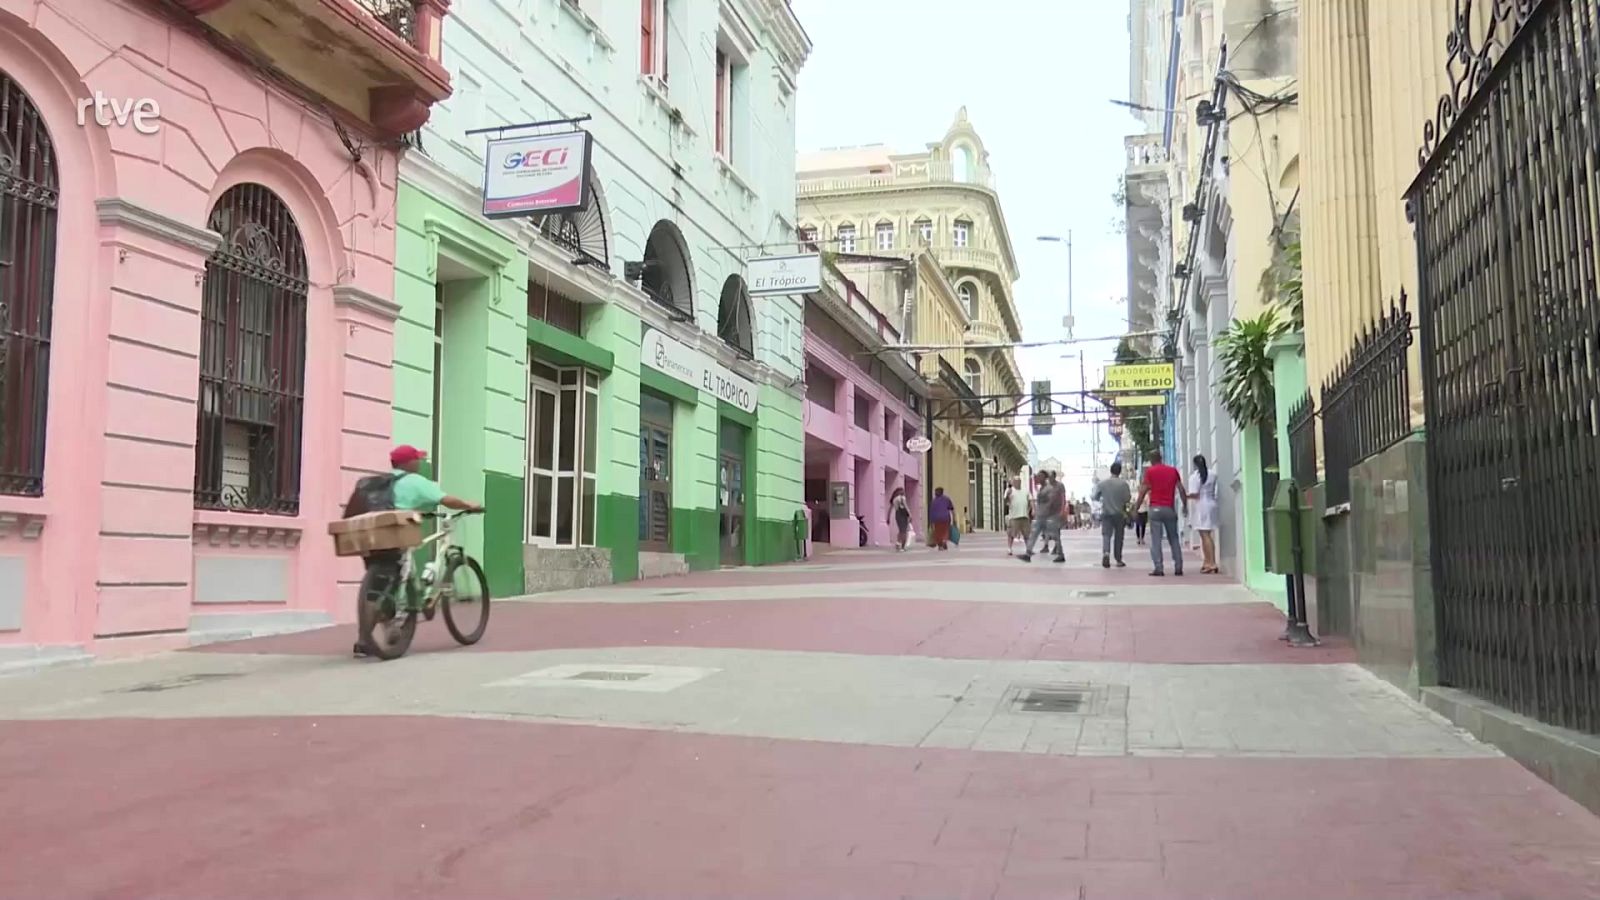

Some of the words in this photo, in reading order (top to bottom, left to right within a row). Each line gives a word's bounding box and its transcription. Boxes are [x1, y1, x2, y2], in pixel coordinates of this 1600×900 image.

[755, 277, 766, 288] El
[770, 275, 807, 287] Trópico
[1120, 366, 1171, 375] BODEGUITA
[703, 369, 714, 392] EL
[716, 376, 749, 408] TRÓPICO
[1107, 379, 1130, 388] DEL
[1133, 377, 1172, 388] MEDIO
